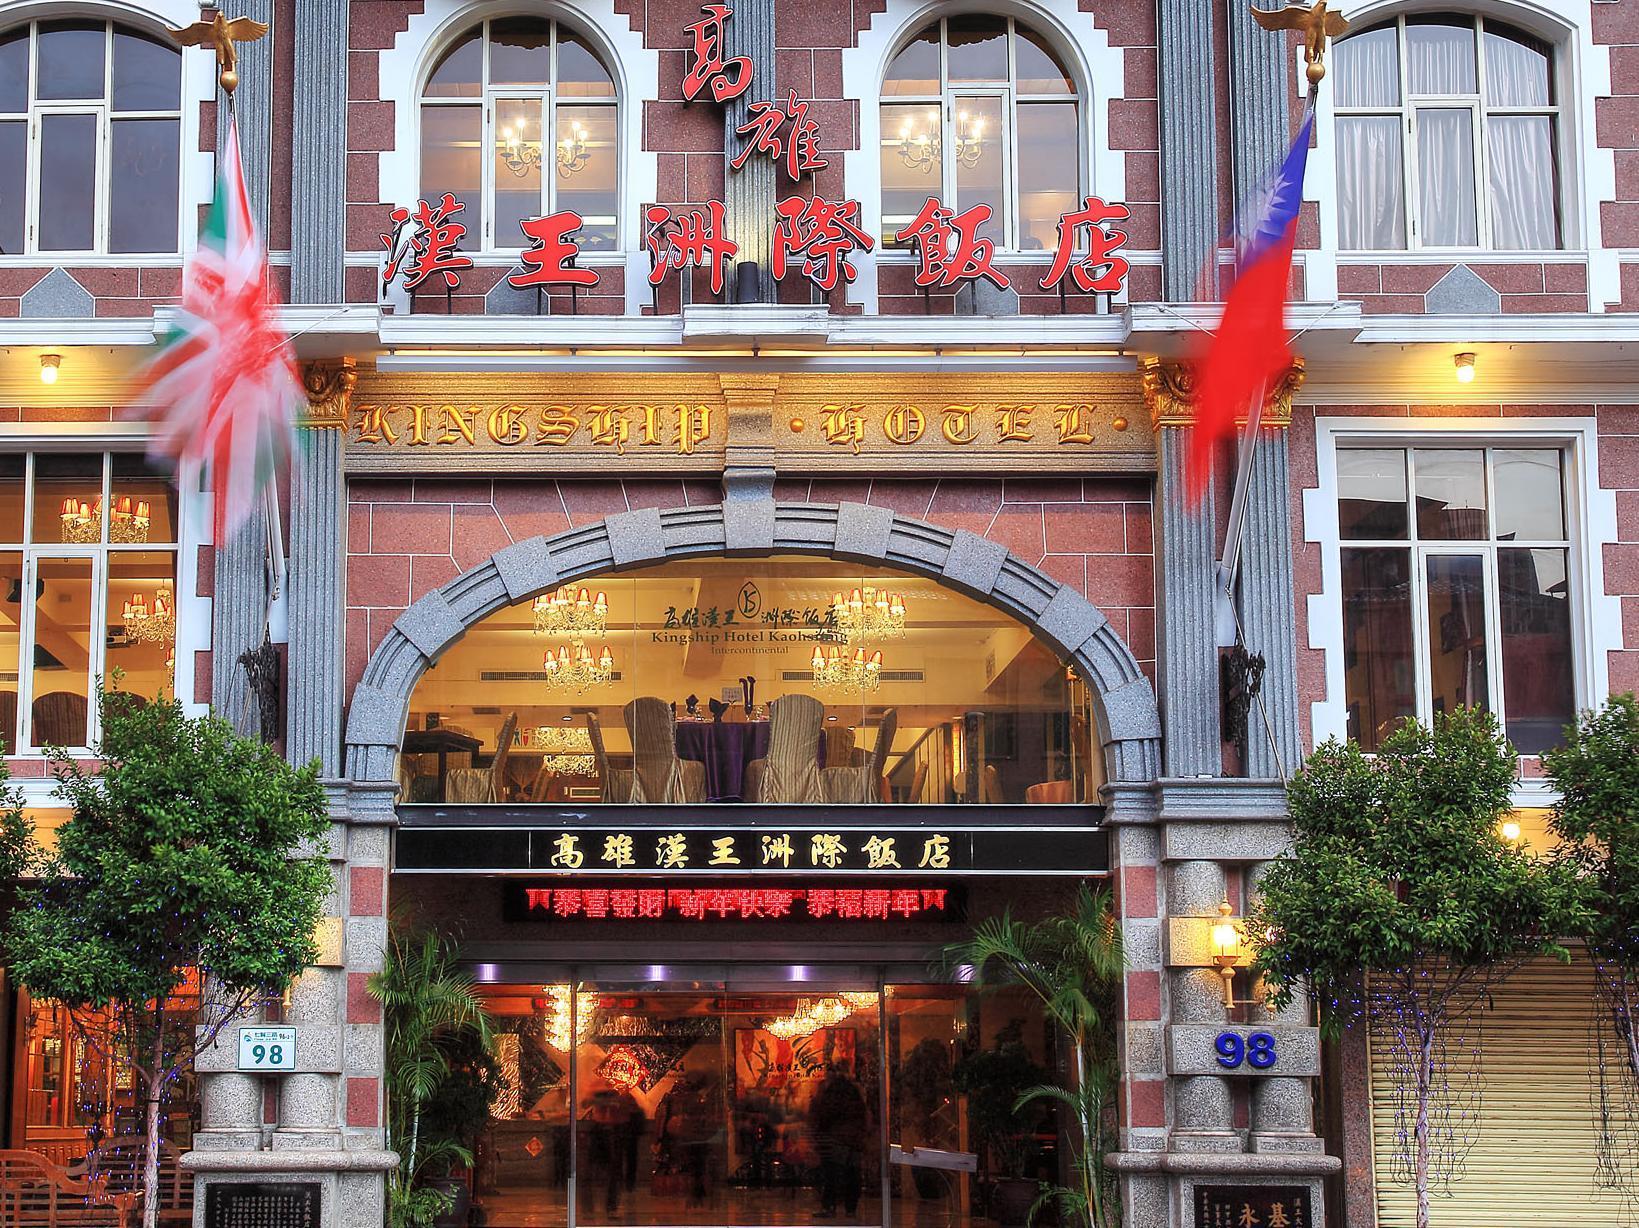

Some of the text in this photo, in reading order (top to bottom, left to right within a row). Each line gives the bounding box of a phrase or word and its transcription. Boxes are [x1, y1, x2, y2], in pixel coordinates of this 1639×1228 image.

[381, 192, 1132, 295] 漢王洲際飯店
[353, 402, 1096, 455] KINGSHIP HOTEL
[652, 631, 849, 645] Kingship Hotel Kaohsing
[550, 833, 952, 869] 高雄漢王洲際飯店
[253, 1045, 283, 1065] 98
[1215, 1032, 1277, 1068] 98
